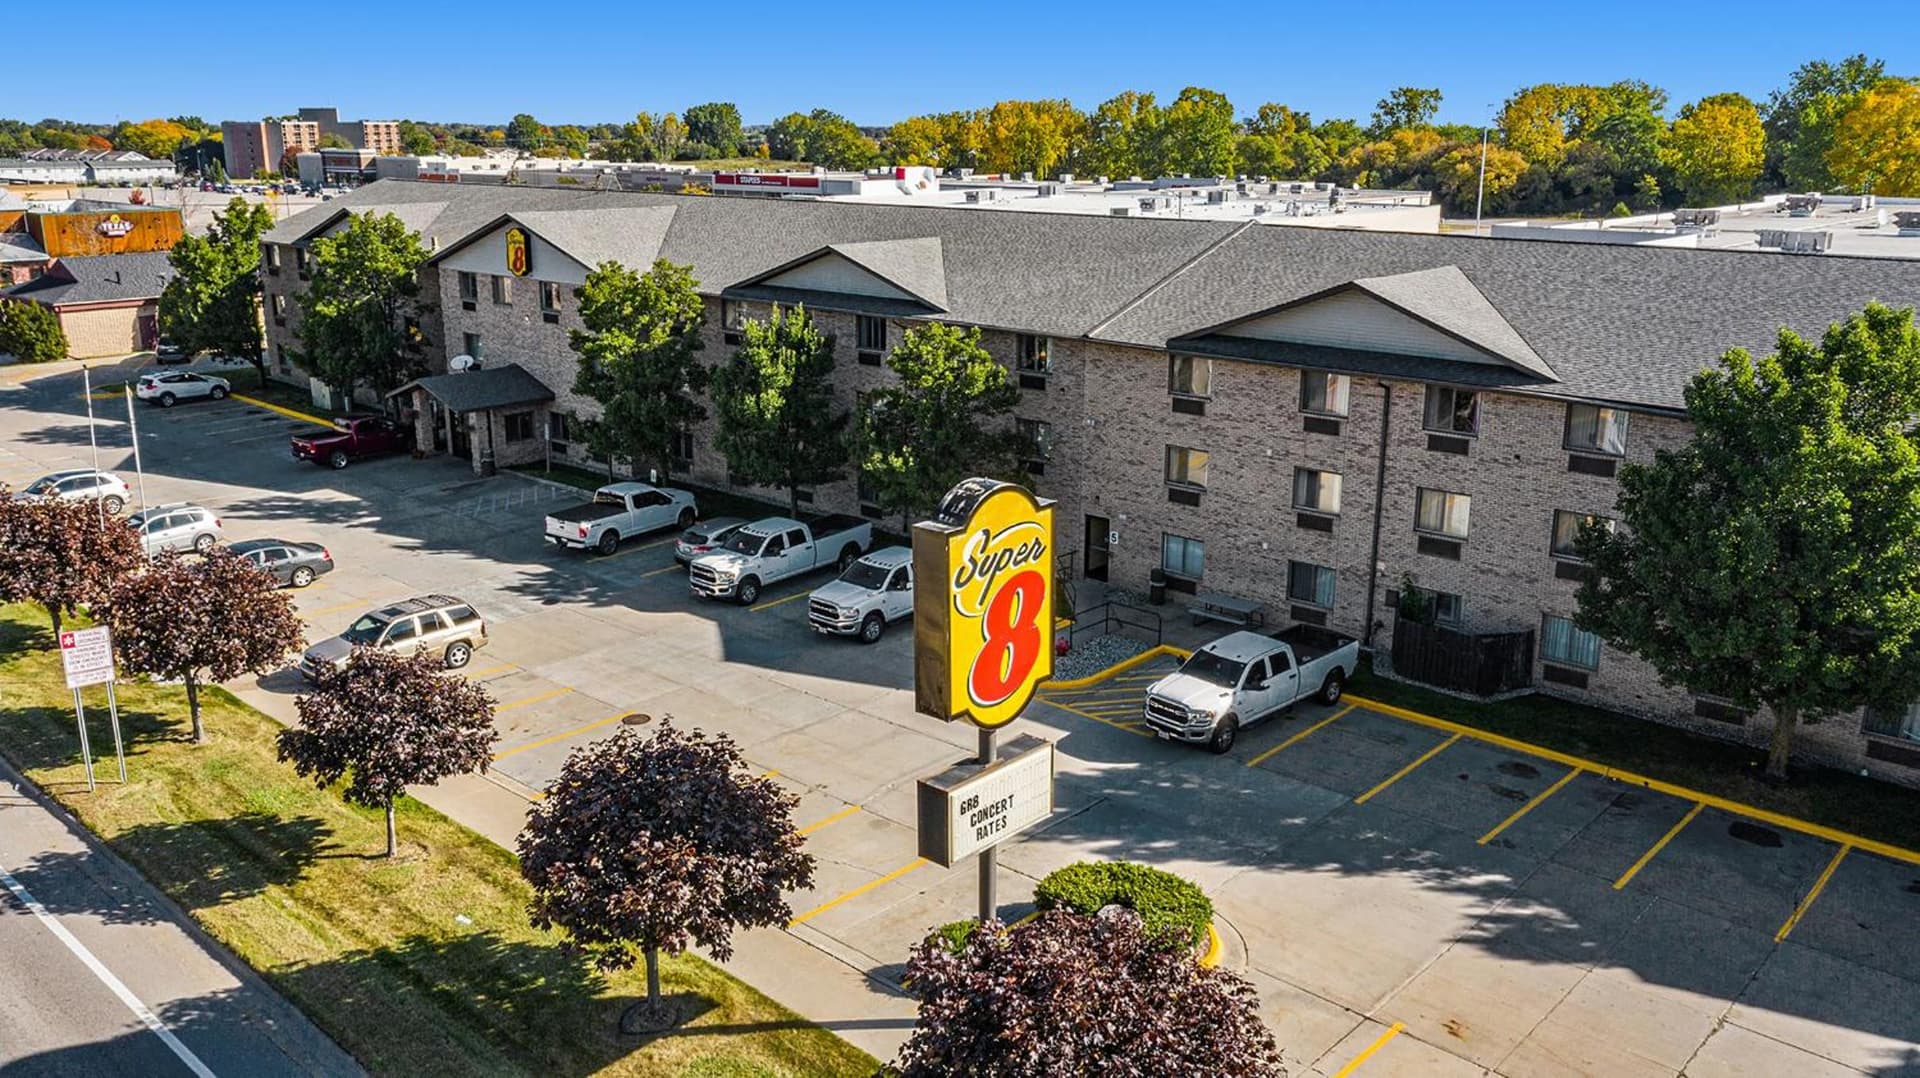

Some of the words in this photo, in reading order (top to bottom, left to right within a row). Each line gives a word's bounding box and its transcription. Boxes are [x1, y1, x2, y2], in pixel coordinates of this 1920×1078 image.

[512, 246, 524, 272] 8
[953, 528, 1047, 609] Super
[967, 570, 1046, 708] 8
[960, 794, 979, 815] GR8
[970, 794, 1014, 827] CONCERT
[976, 815, 1007, 841] RATES
